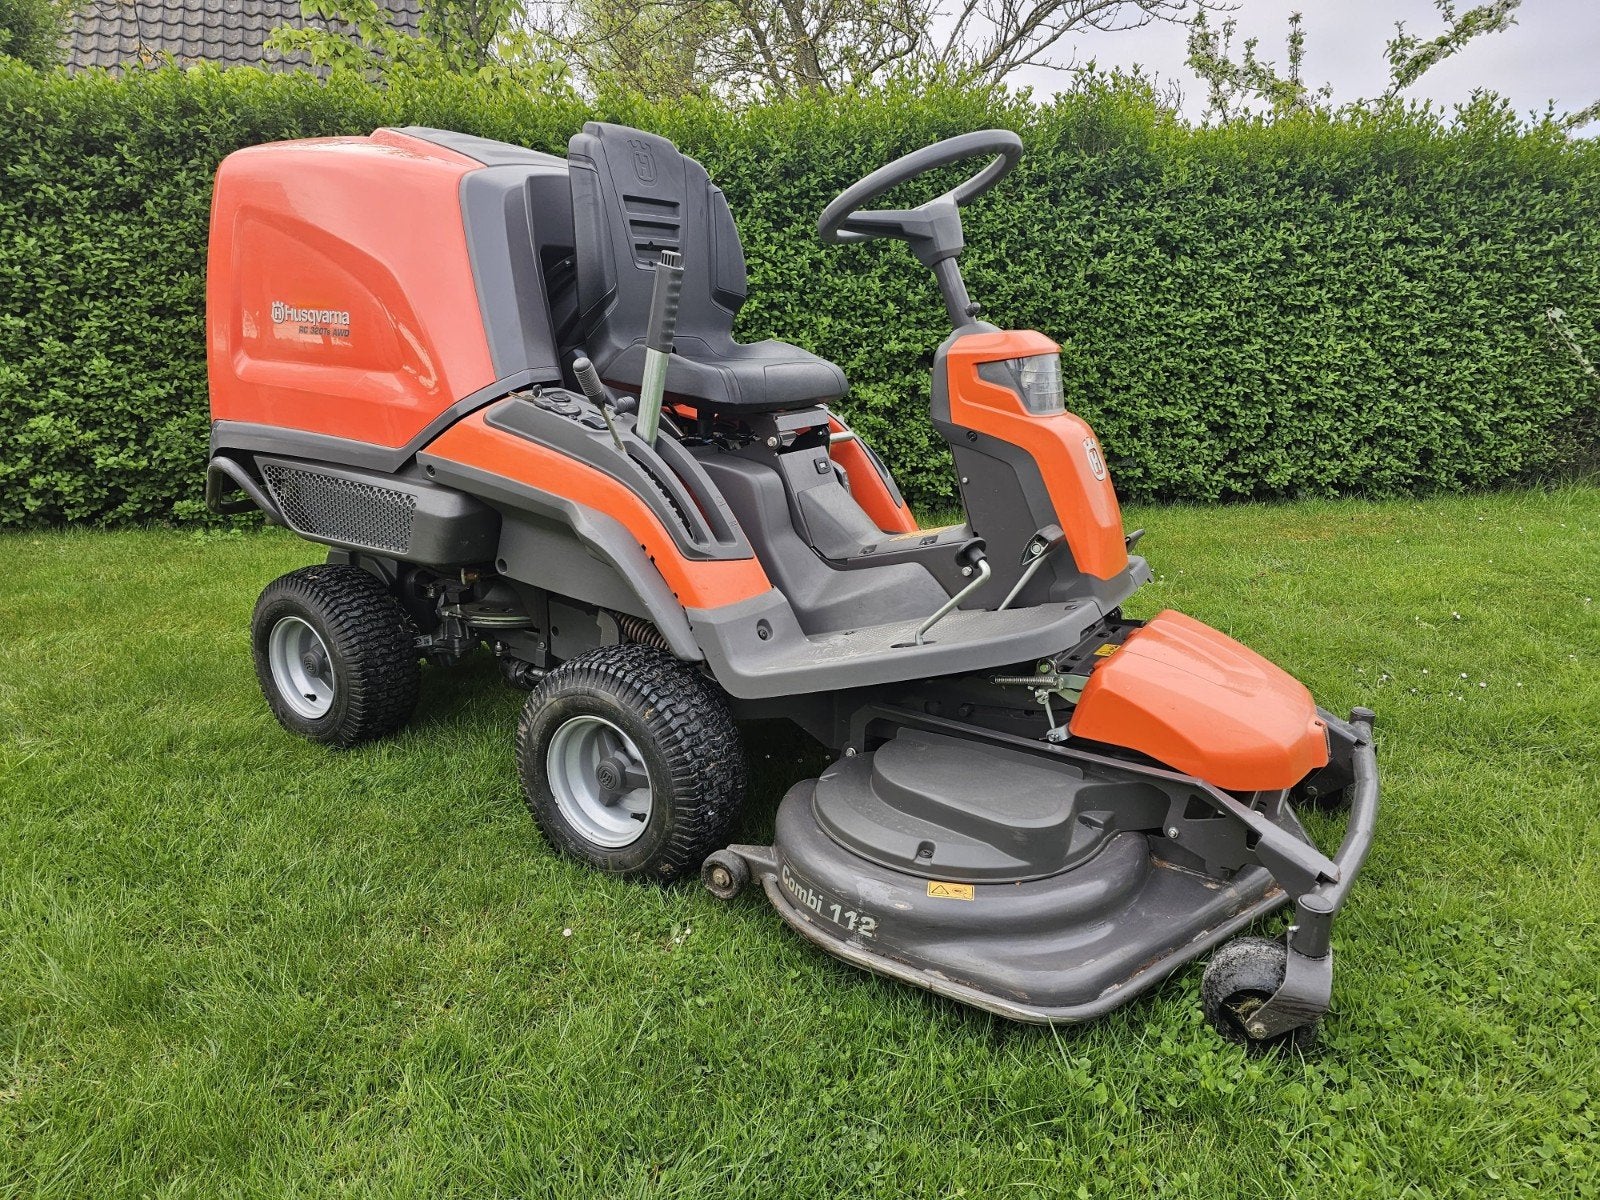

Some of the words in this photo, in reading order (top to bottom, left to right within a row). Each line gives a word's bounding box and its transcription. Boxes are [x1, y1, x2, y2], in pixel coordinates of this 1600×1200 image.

[285, 304, 350, 326] Husqvarna
[298, 325, 309, 334] RC
[332, 328, 350, 338] AWD
[782, 865, 823, 914] Combi
[829, 903, 877, 938] 112
